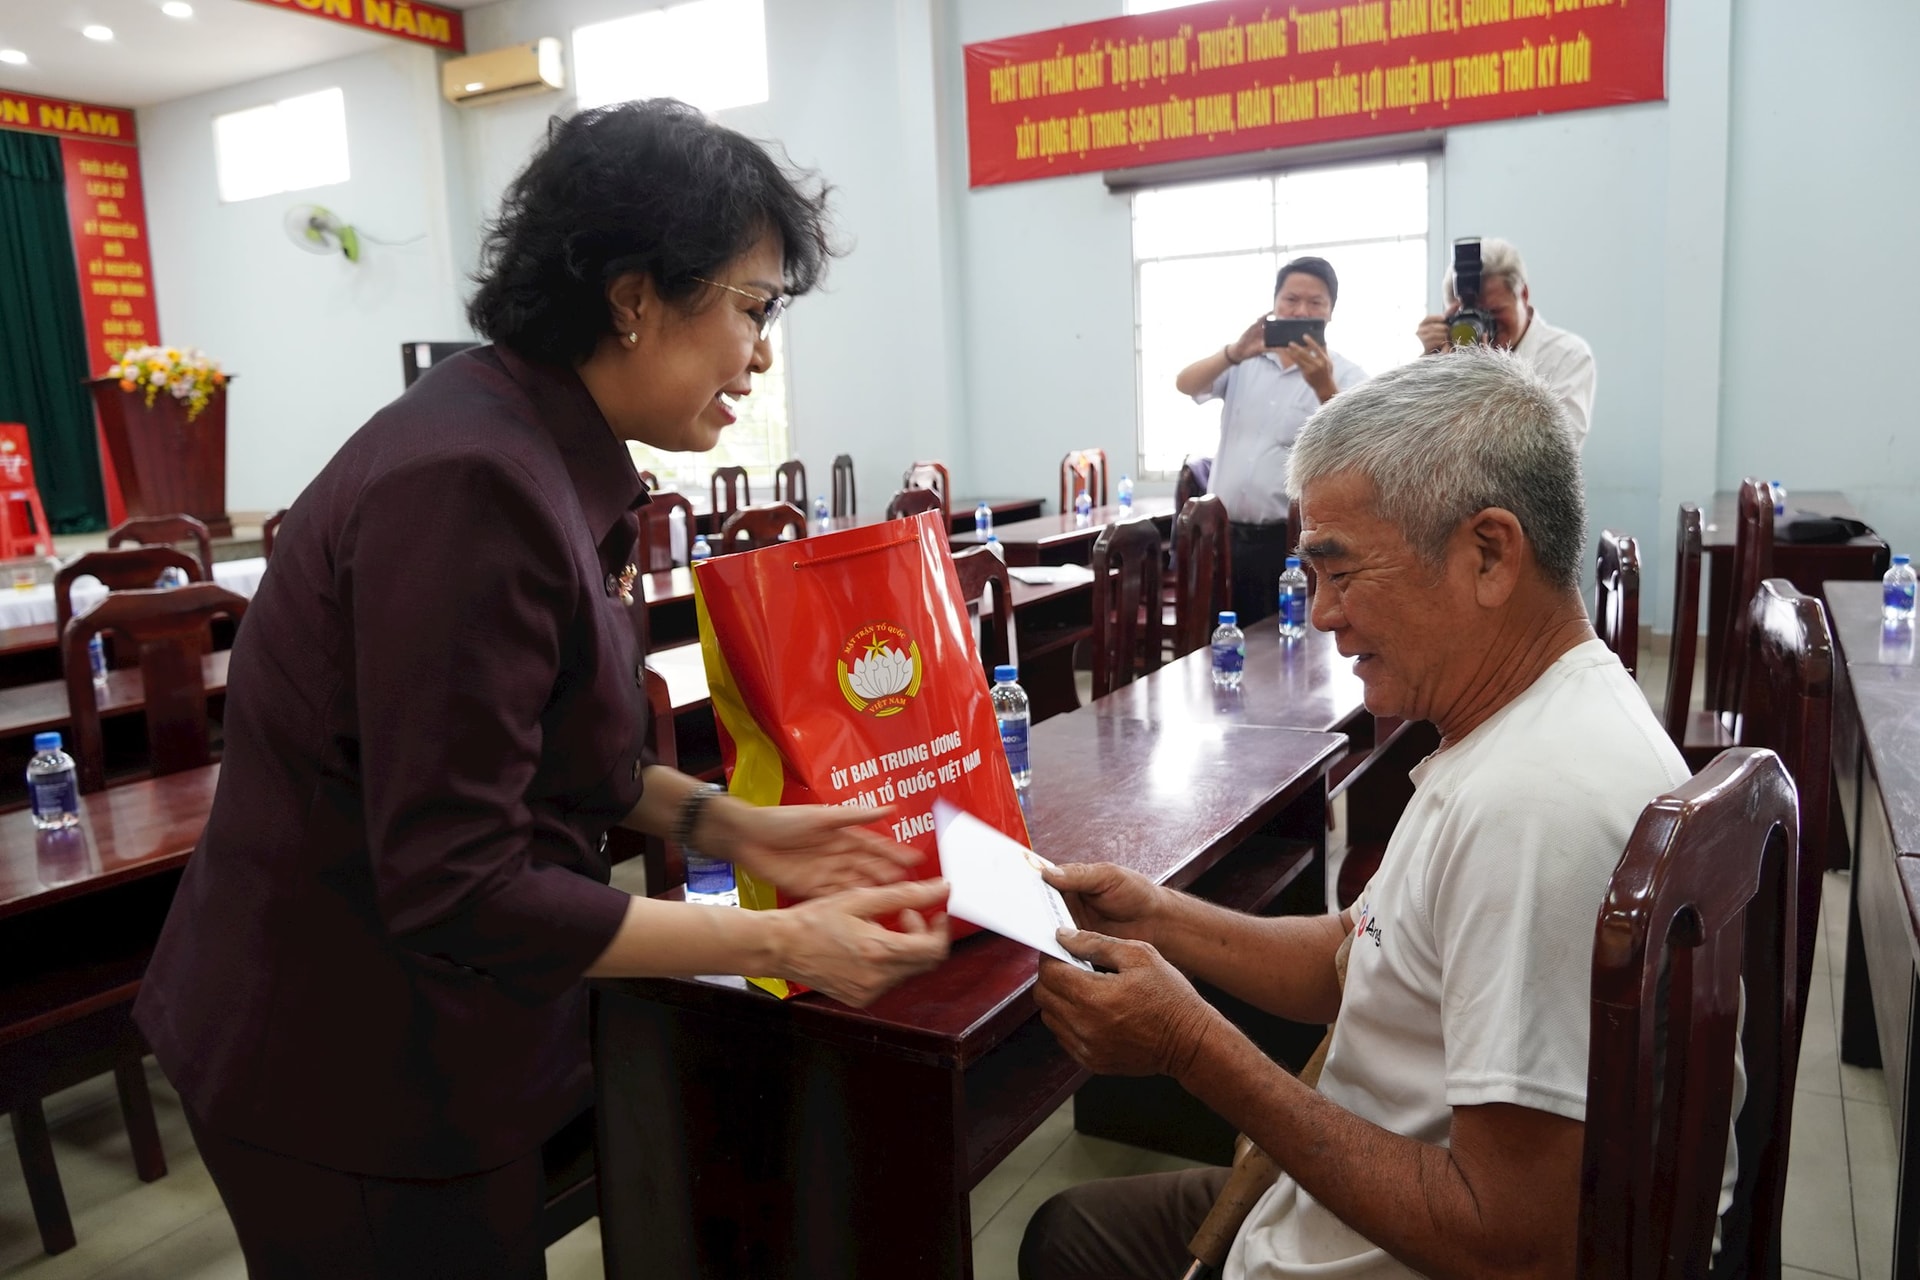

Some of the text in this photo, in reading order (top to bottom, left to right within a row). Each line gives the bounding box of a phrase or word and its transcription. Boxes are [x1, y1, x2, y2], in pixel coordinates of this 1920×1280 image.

[989, 58, 1017, 104] PHÁT
[1019, 61, 1039, 100] HUY
[1041, 42, 1074, 96] PHẨM
[1075, 38, 1104, 90] CHẤT
[1129, 35, 1149, 89] ĐỘI
[1197, 15, 1244, 70] TRUYỀN
[1245, 6, 1287, 62] THỐNG
[1016, 115, 1037, 159] XÂY
[1038, 115, 1069, 163] DỰNG
[1090, 108, 1128, 149] TRONG
[1129, 103, 1161, 151] SẠCH
[1161, 94, 1194, 140] VỮNG
[1236, 79, 1271, 129] HOÀN
[1272, 74, 1315, 124] THÀNH
[1316, 60, 1360, 118] THẮNG
[1361, 65, 1384, 120] LỢI
[1385, 55, 1430, 115] NHIỆM
[1431, 57, 1452, 110] VỤ
[1453, 50, 1500, 99] TRONG
[1502, 37, 1535, 93] THỜI
[1537, 34, 1558, 88] KỲ
[1560, 29, 1590, 85] MỚI
[39, 102, 120, 137] NĂM
[887, 625, 906, 640] QUỐC
[869, 697, 907, 714] VIỆT NAM
[830, 730, 962, 790] ỦY BAN TRUNG ƯƠNG
[877, 776, 895, 805] TỔ
[896, 767, 937, 799] QUỐC
[937, 759, 961, 784] VIỆT
[962, 748, 982, 774] NAM
[891, 812, 936, 844] TẶNG
